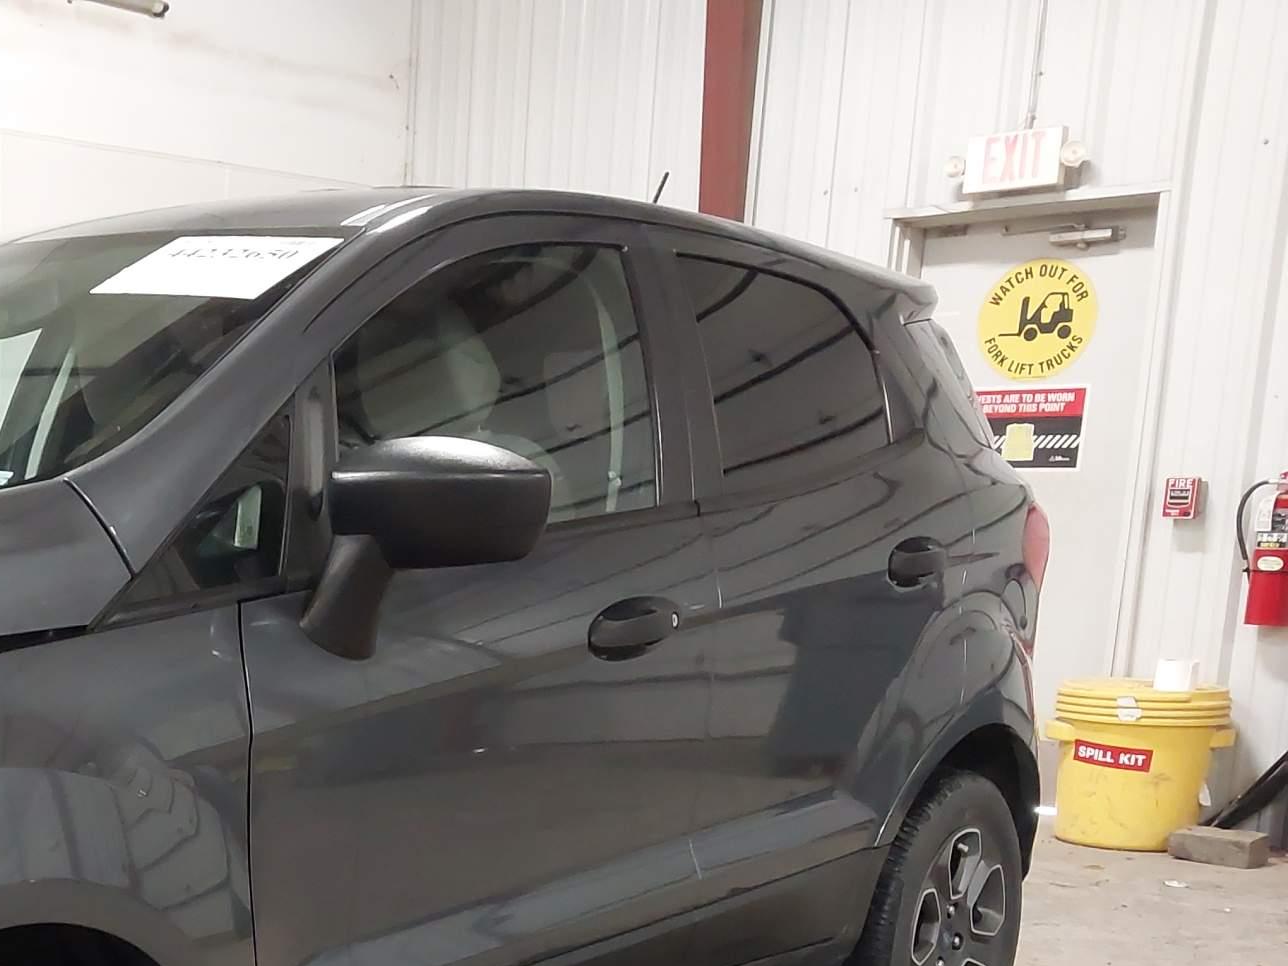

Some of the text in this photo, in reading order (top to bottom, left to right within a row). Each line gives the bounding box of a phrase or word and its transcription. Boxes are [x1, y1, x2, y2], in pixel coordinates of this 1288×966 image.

[983, 131, 1046, 184] EXIT
[989, 264, 1089, 306] WATCH OUT FOR
[984, 335, 1083, 375] FORK LIFT TRUCKS
[982, 402, 1065, 413] BEYOND THIS POINT
[1003, 393, 1020, 403] ARE
[1021, 393, 1033, 403] TO
[1035, 393, 1046, 402] BE
[1047, 392, 1075, 402] WORN
[1169, 479, 1193, 488] FIRE
[1078, 745, 1147, 766] SPILL KIT
